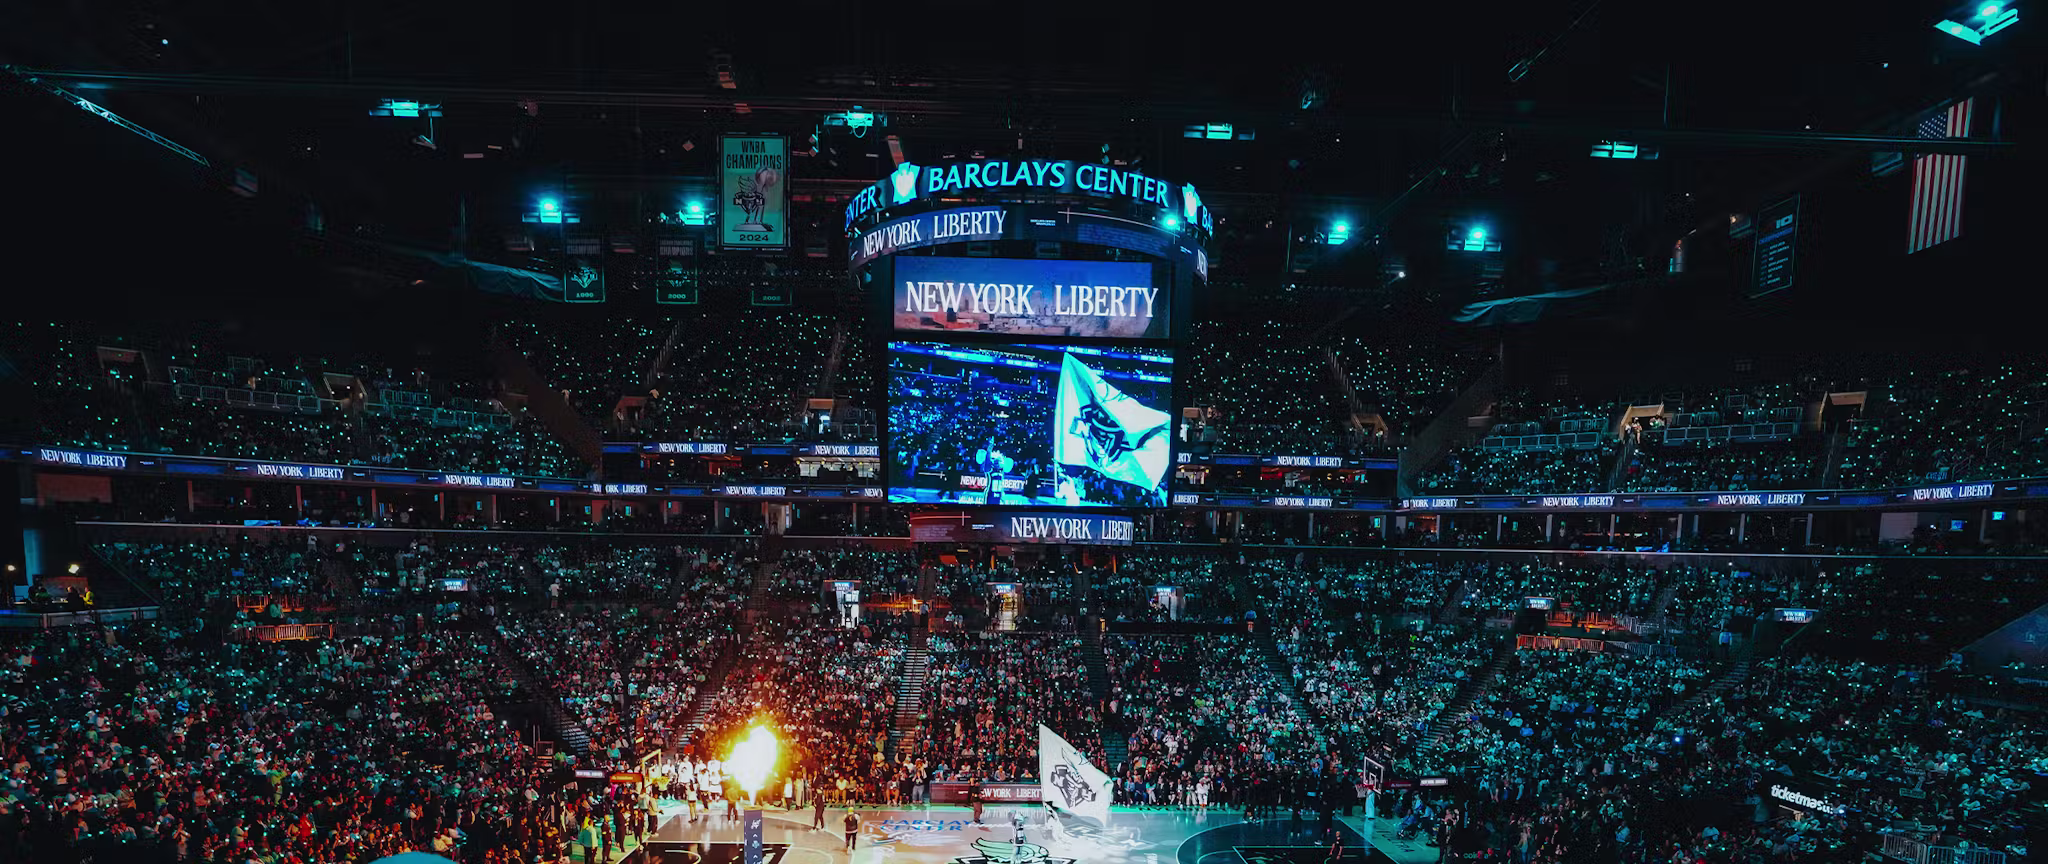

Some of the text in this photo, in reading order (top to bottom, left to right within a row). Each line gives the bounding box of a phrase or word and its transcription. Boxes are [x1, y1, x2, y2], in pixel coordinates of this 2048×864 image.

[741, 140, 766, 153] WNBA
[726, 154, 782, 170] CHAMPIONS
[929, 161, 1169, 208] BARCLAYS CENTER
[844, 185, 878, 231] ENTER
[739, 234, 769, 242] 2024
[863, 210, 1007, 259] NEW YORK LIBERTY
[906, 281, 1159, 318] NEW YORK LIBERTY
[659, 443, 727, 453] NEW YORK LIBERTY
[815, 445, 879, 455] NEW YORK LIBERT
[40, 449, 127, 467] NEW YORK LIBERTY
[1177, 453, 1192, 463] RTY
[1278, 456, 1342, 466] NEW YORK LIBERTY
[257, 464, 279, 475] NEW
[279, 465, 303, 477] YORK
[309, 467, 344, 479] LIBERTY
[446, 475, 515, 487] NEW YORK LIBERTY
[977, 476, 988, 487] YO
[605, 484, 619, 493] ORK
[726, 486, 787, 496] NEW YORK LIBERTY
[1913, 484, 1995, 500] NEW YORK LIBERTY
[1274, 497, 1333, 507] NEW YORK LIBERTY
[1543, 496, 1615, 506] NEW YORK LIBERTY
[1717, 494, 1805, 505] NEW YORK LIBERTY
[1011, 516, 1050, 539] NEW
[1050, 518, 1092, 540] YORK
[992, 788, 1012, 798] YORK
[1016, 788, 1042, 798] LIBERT
[1771, 784, 1834, 814] ticketmas
